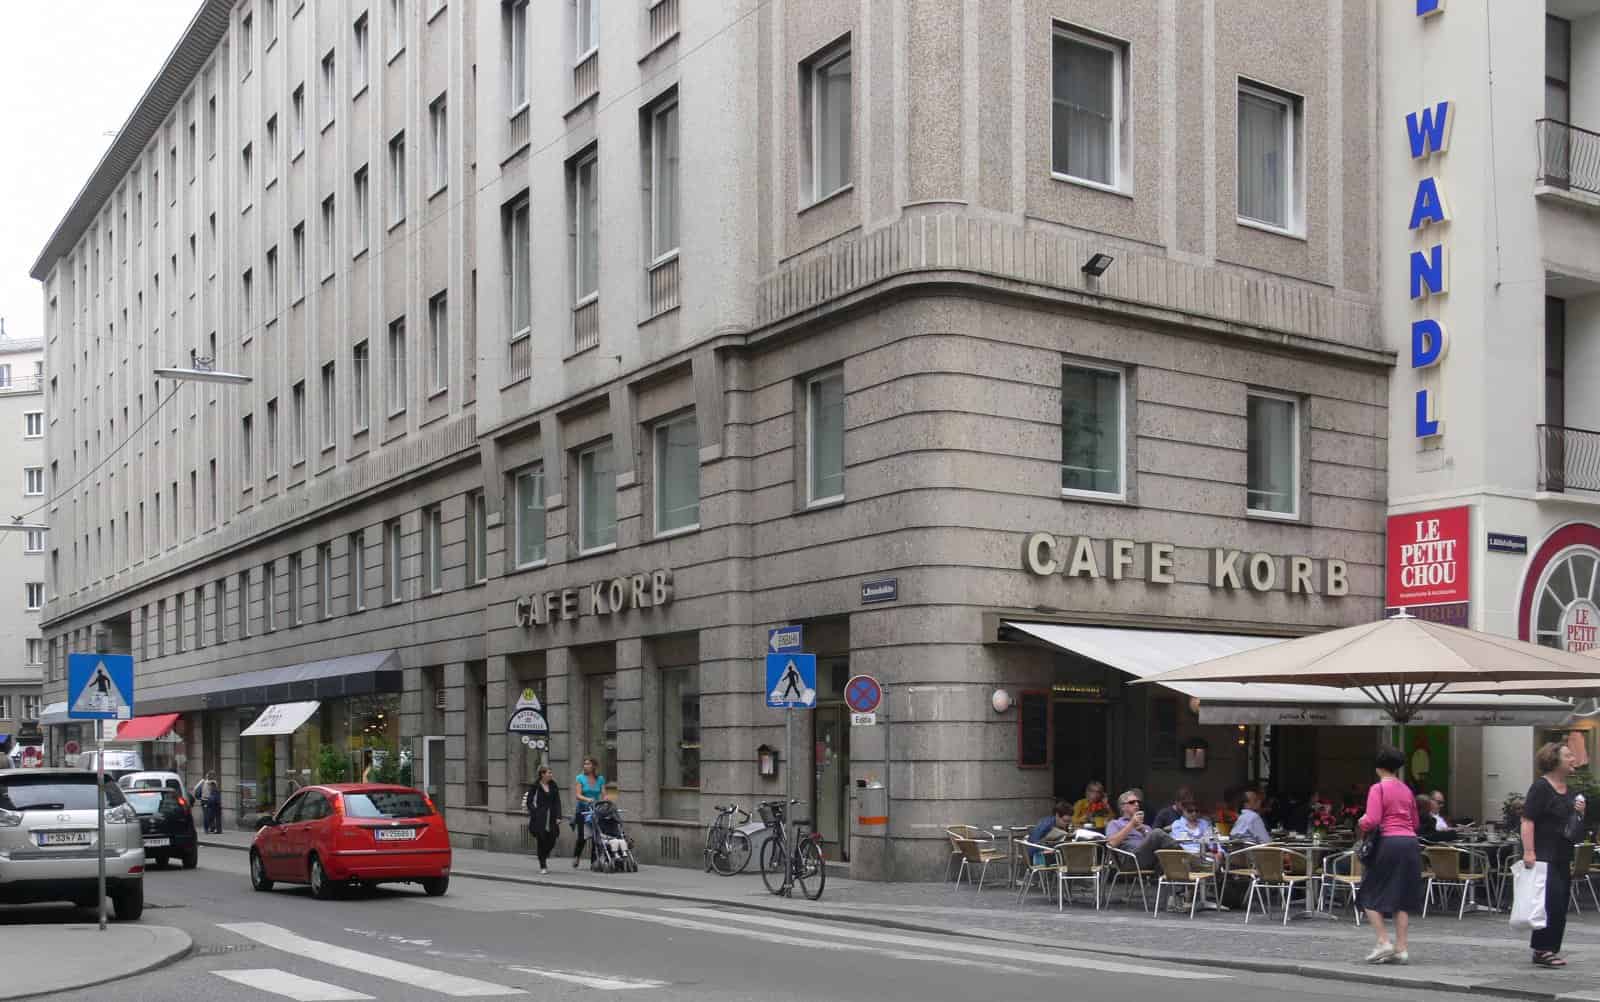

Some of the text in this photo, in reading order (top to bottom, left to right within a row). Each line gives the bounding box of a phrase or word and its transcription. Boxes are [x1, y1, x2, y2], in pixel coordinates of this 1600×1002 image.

[1405, 99, 1453, 440] WANDL
[1415, 519, 1440, 542] LE
[1024, 532, 1349, 597] CAFE KORB
[1400, 540, 1457, 566] PETIT
[1400, 562, 1457, 588] CHOU
[514, 568, 673, 627] CAFE KORB
[1576, 609, 1589, 625] LE
[1568, 624, 1598, 642] PETIT
